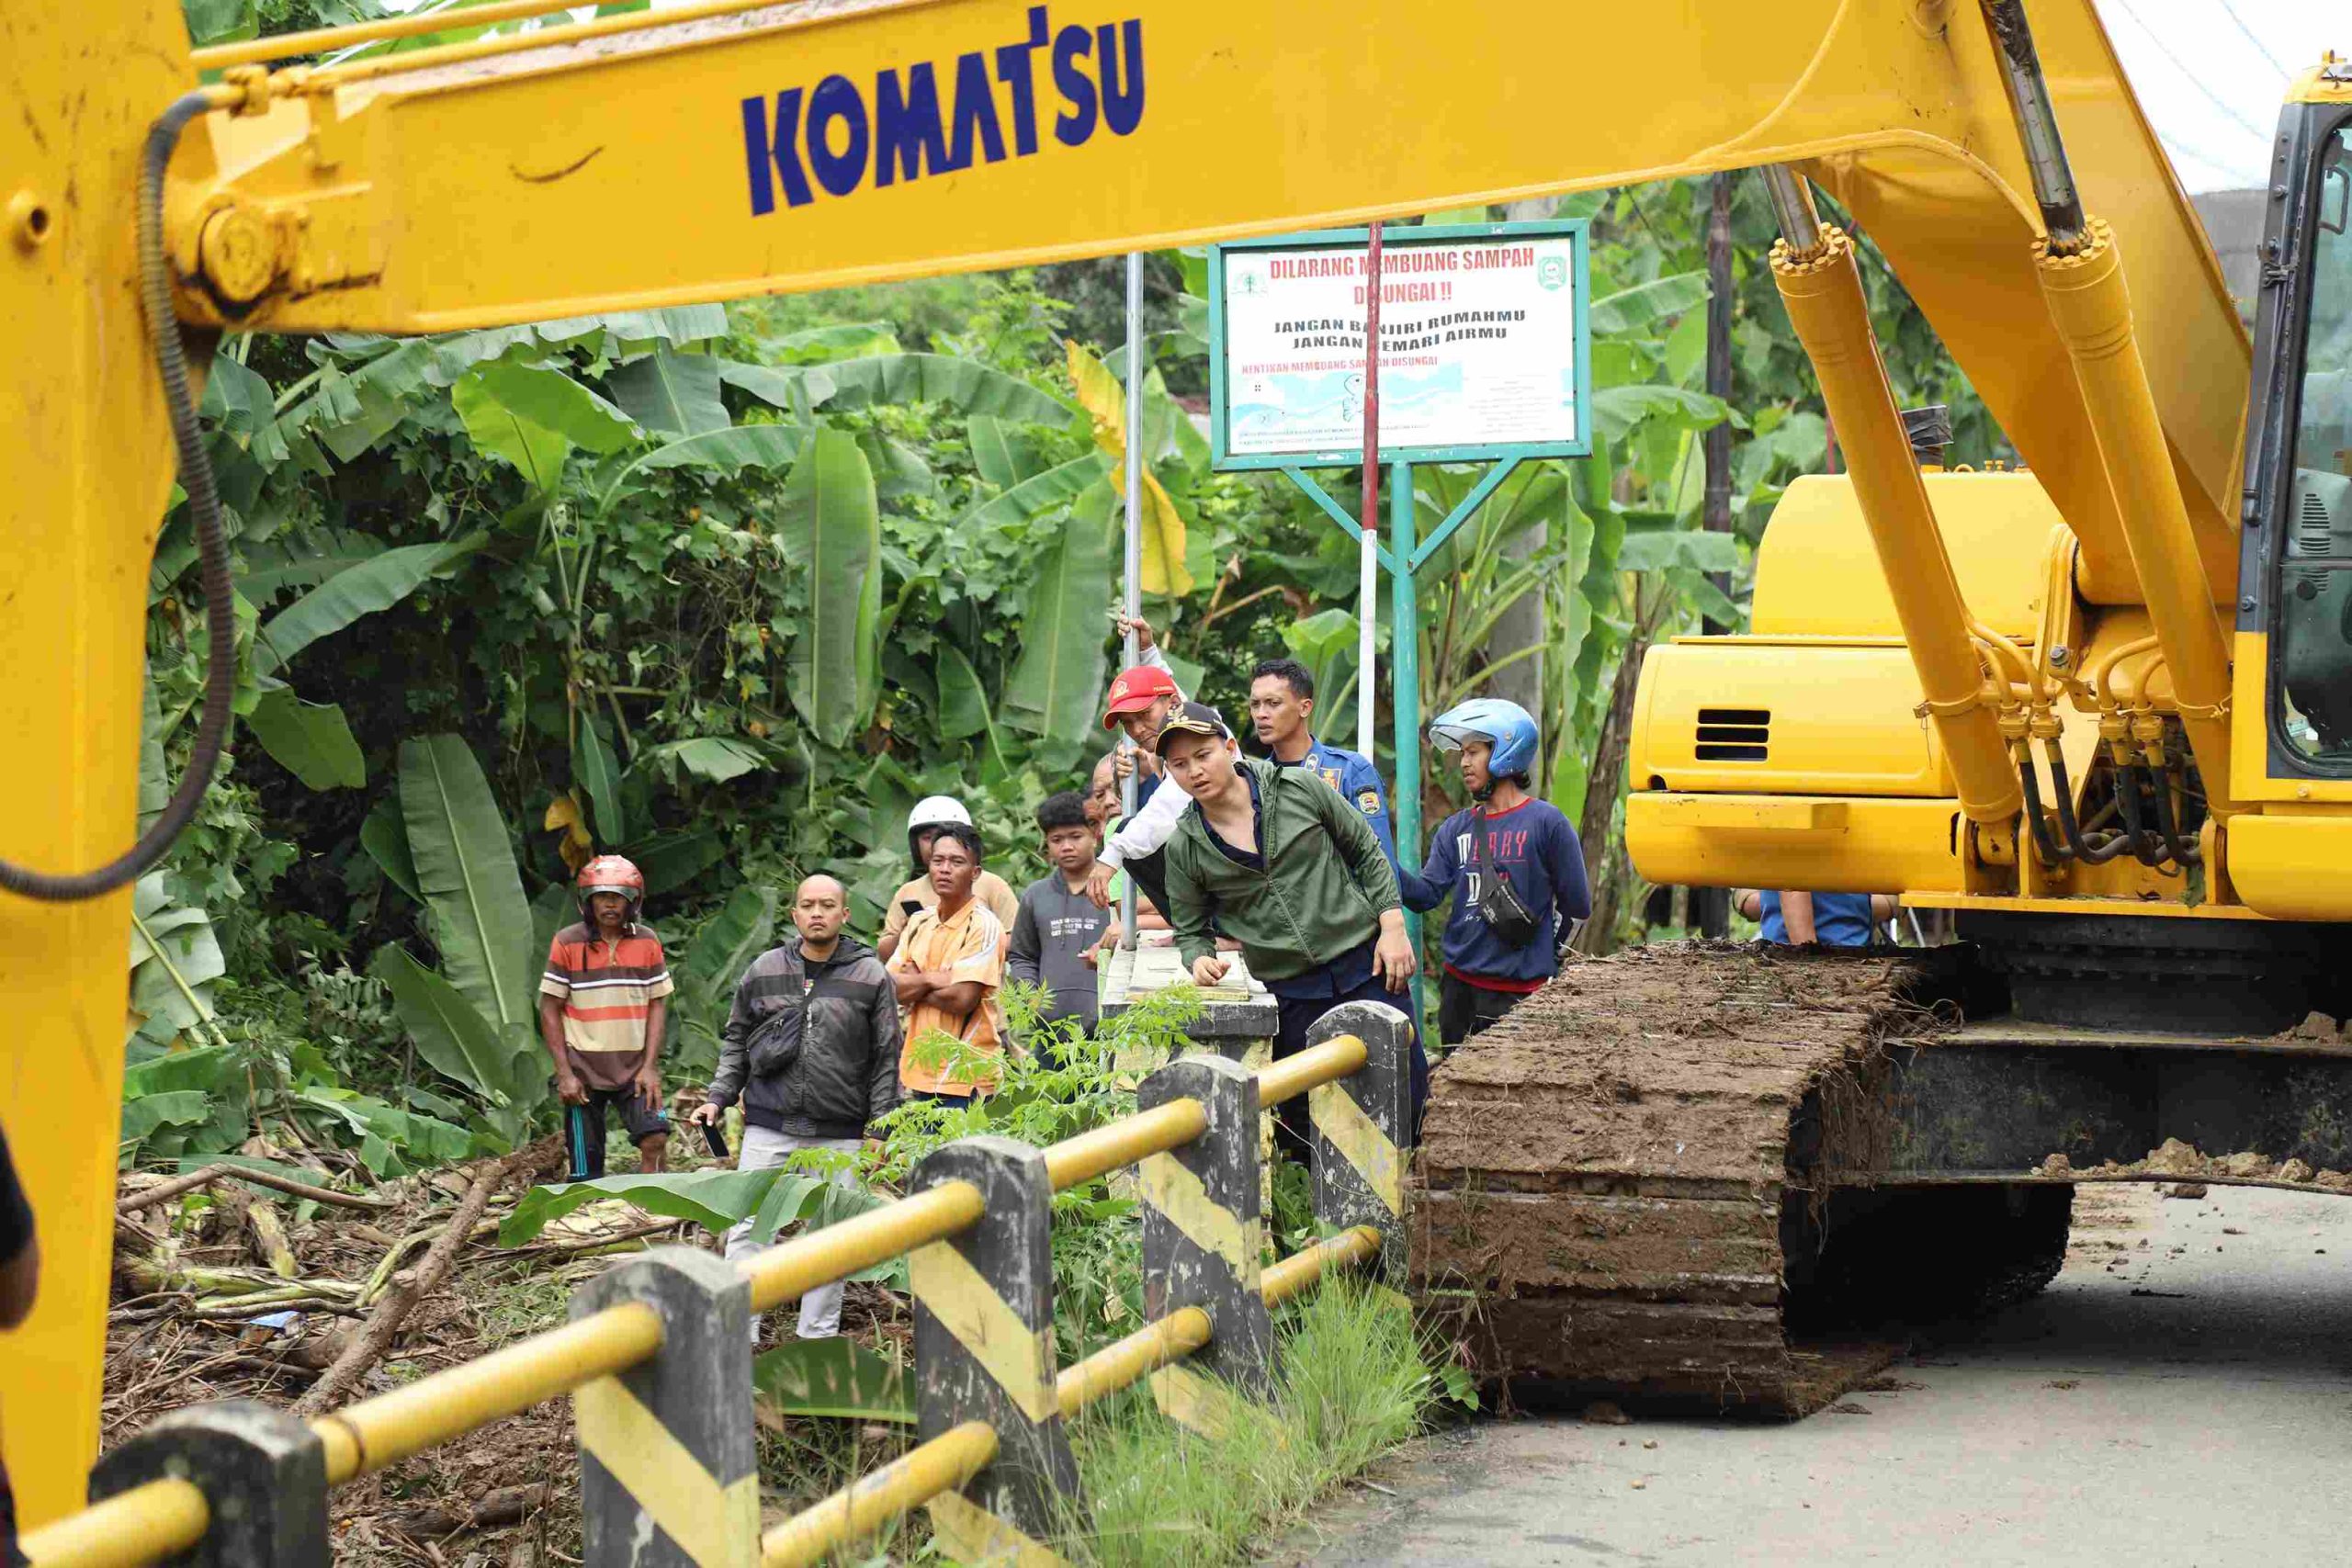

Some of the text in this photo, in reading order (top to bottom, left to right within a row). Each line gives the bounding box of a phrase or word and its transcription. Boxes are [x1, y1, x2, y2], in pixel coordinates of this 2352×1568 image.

[741, 5, 1146, 218] KOMATSU
[1270, 247, 1534, 279] DILARANG MMBUANG SAMPAH
[1354, 281, 1436, 305] DUNGAI
[1273, 319, 1344, 333] JANGAN
[1428, 310, 1526, 330] RUMAHMU
[1292, 327, 1508, 352] JANGAN EMARI AIRMU
[1349, 356, 1389, 369] SAMAH
[1392, 355, 1438, 367] DISUNGAI
